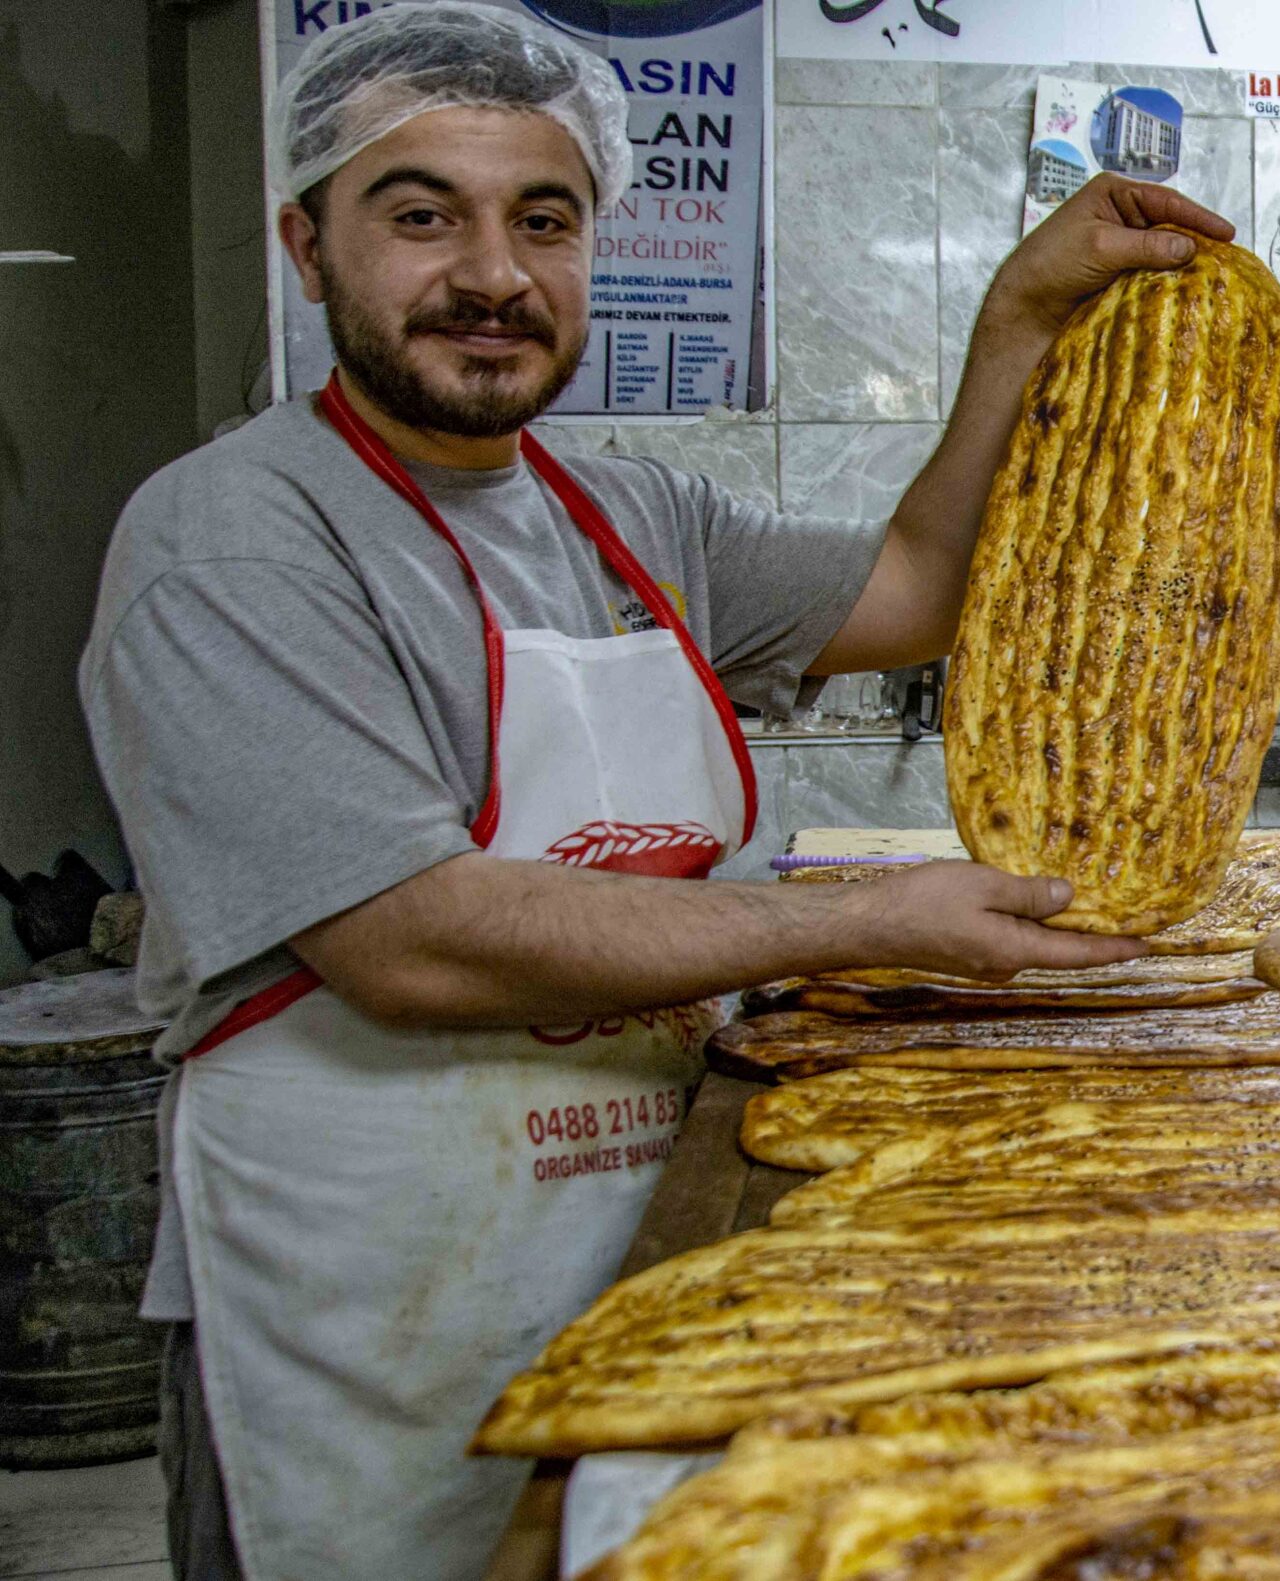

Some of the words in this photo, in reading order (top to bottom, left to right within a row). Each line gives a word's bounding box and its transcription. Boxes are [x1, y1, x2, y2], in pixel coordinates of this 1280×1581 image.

[1249, 73, 1271, 97] La
[627, 111, 732, 148] AN
[631, 155, 729, 192] SIN
[652, 198, 726, 224] TOK
[626, 310, 661, 321] DEVAM
[527, 1102, 600, 1146] 0488
[606, 1094, 650, 1136] 214
[655, 1088, 679, 1126] 85
